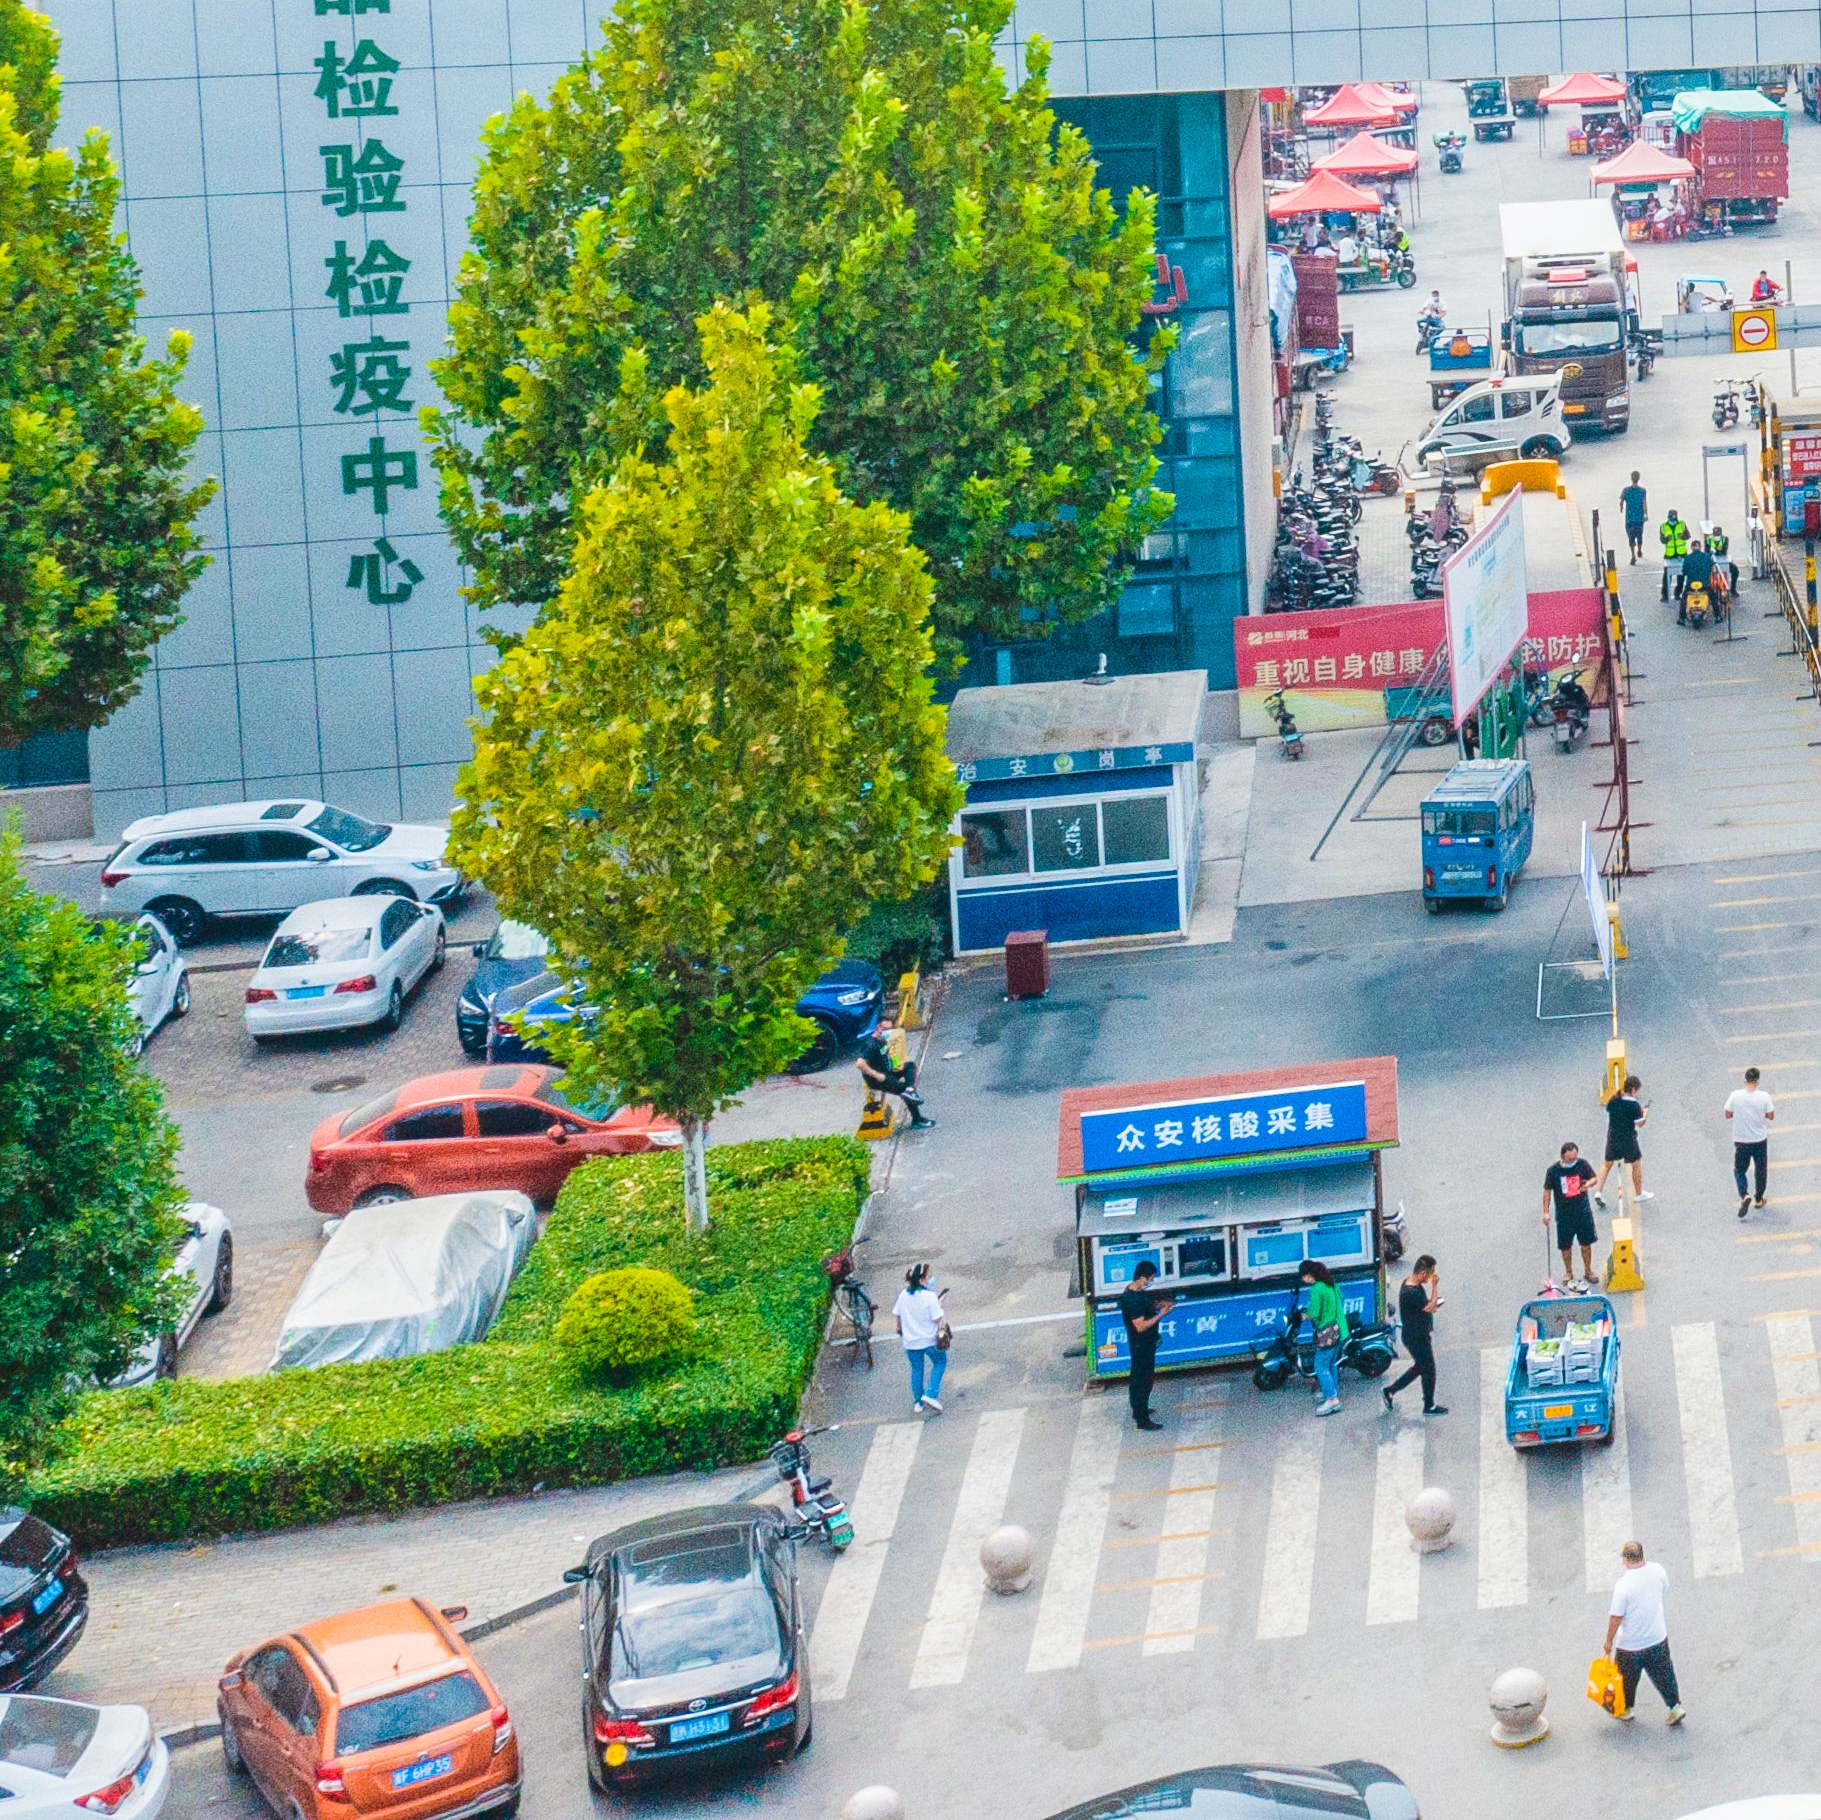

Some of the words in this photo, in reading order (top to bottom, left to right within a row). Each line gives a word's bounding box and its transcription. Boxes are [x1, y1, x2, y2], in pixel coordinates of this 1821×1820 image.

[1253, 647, 1424, 689] 重视自身健康
[1116, 1102, 1335, 1154] 众安核酸采集
